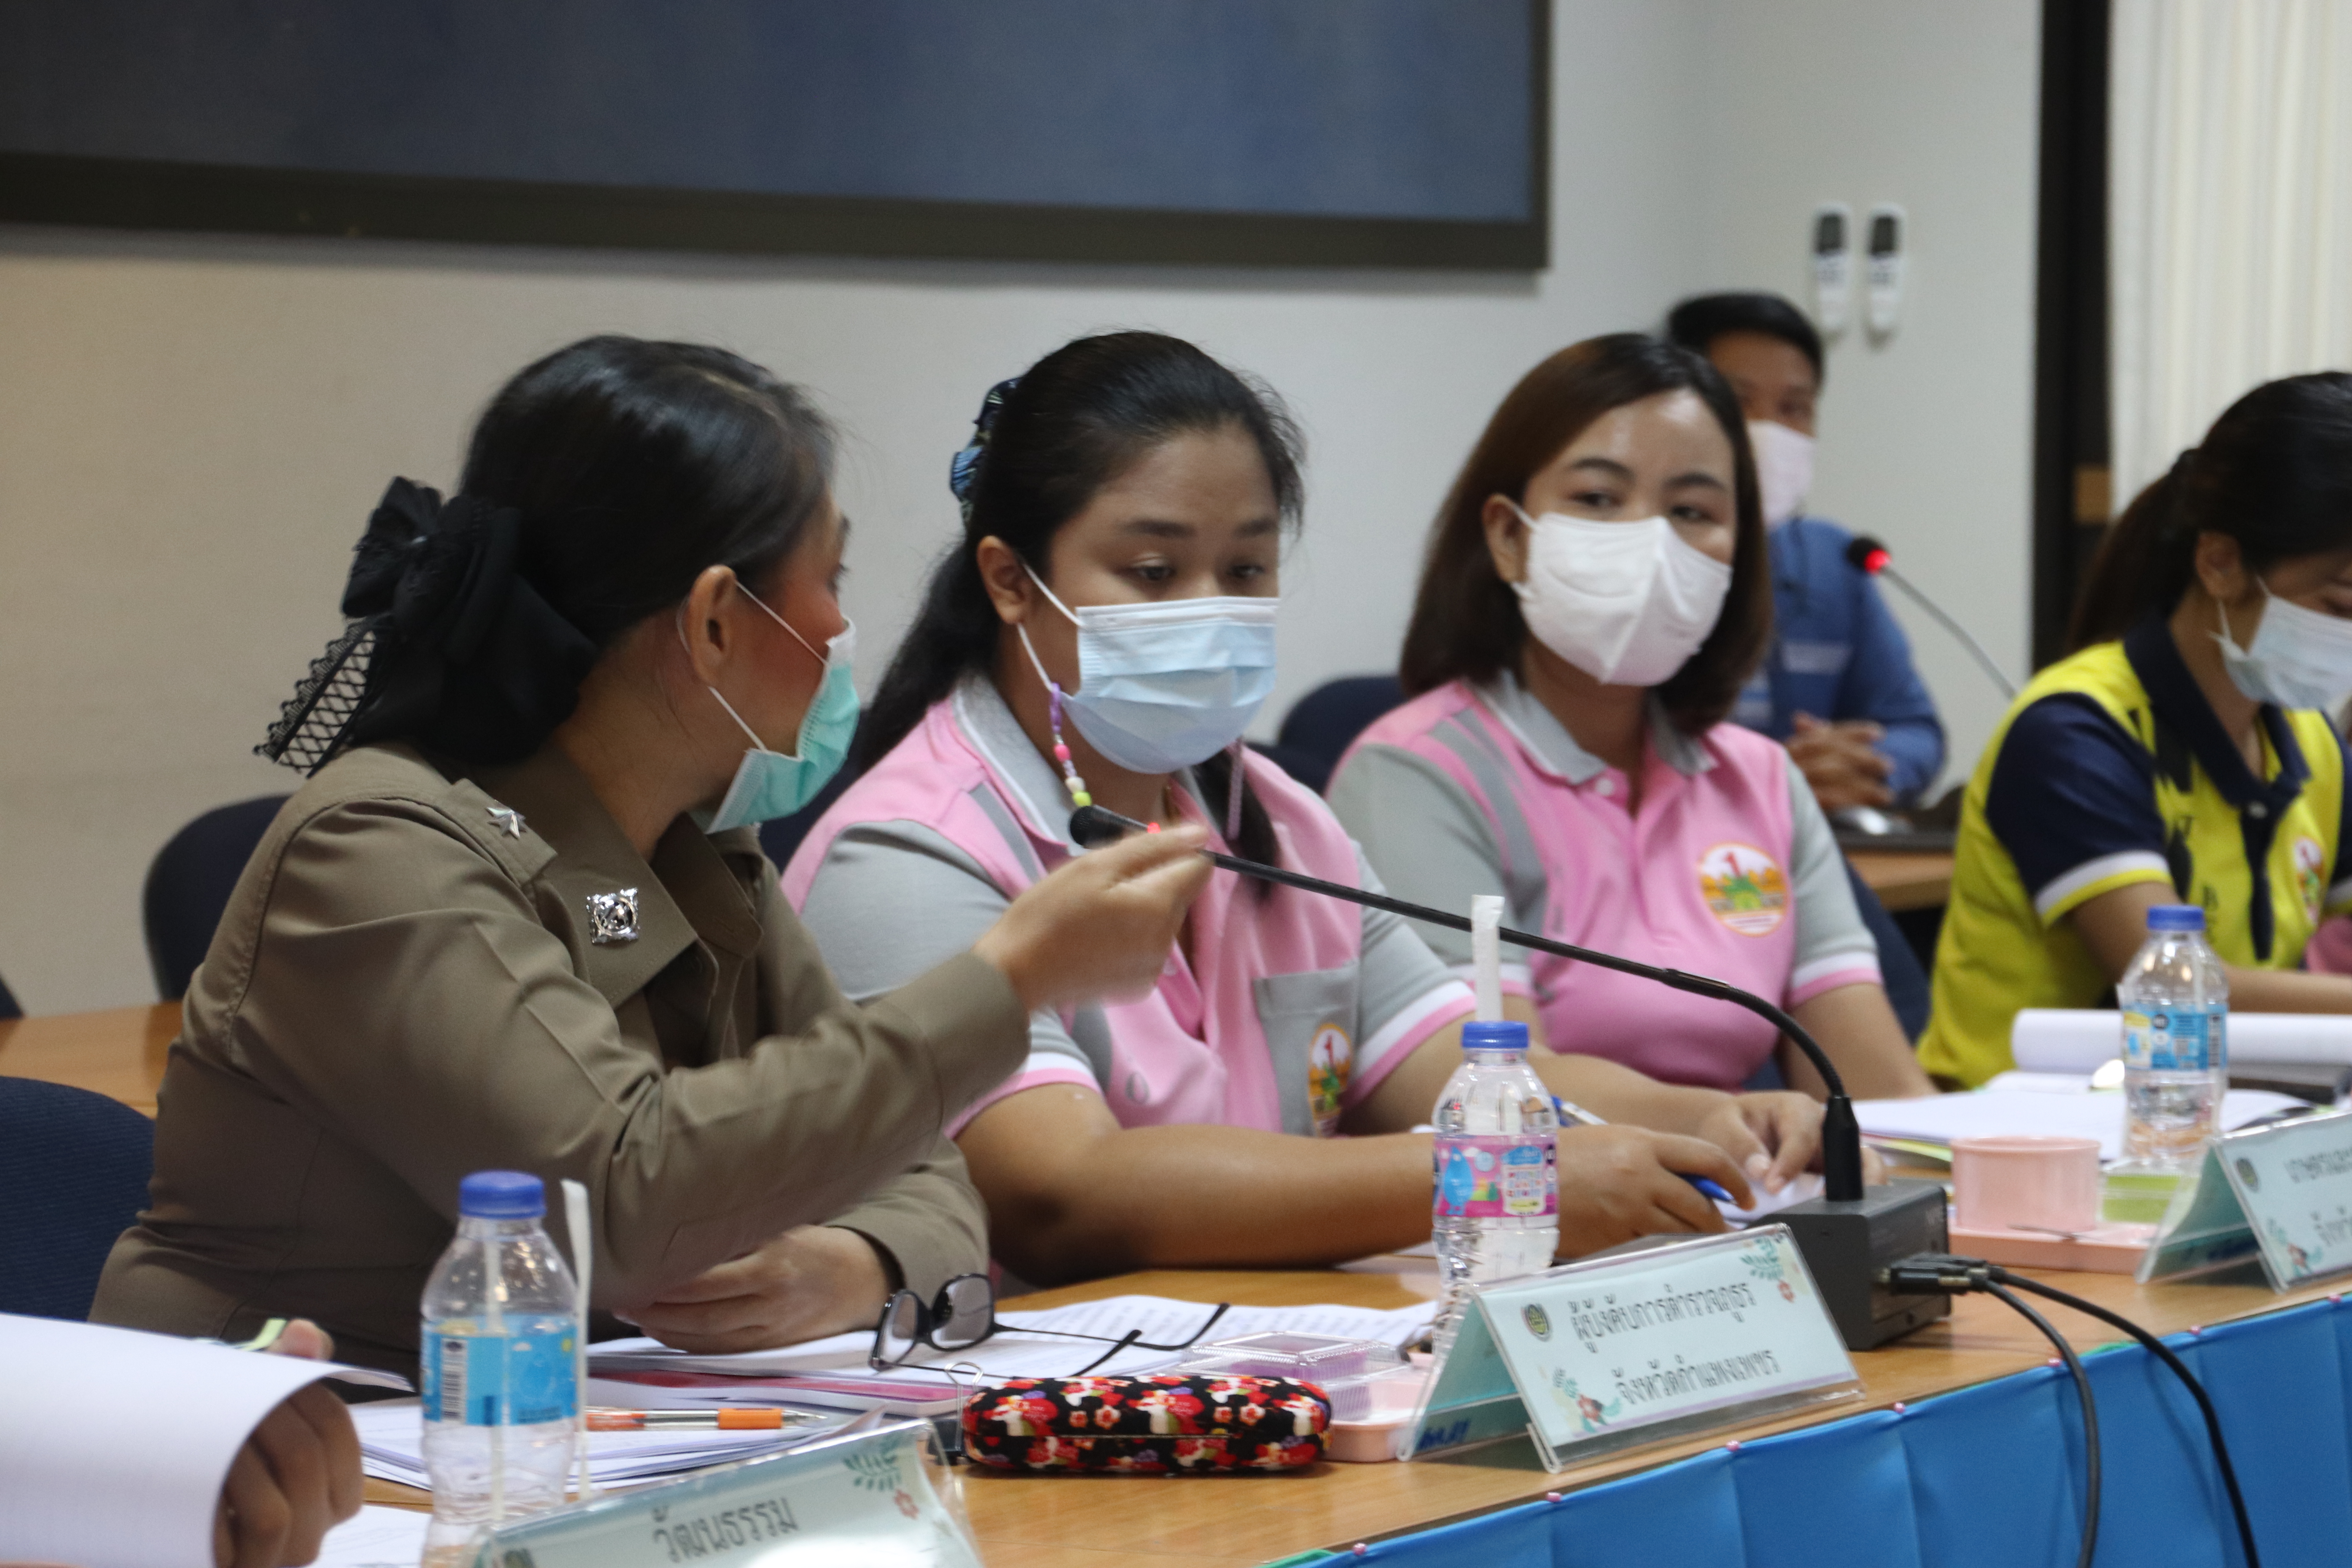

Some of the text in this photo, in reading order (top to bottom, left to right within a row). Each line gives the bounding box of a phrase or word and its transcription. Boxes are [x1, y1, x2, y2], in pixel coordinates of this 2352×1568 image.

[1569, 1283, 1756, 1354] ผู้บังคับการตำรวจภูธร
[1612, 1350, 1781, 1405] จังหวัดกำแพงเพชร
[652, 1497, 799, 1563] วัฒนธรรม
